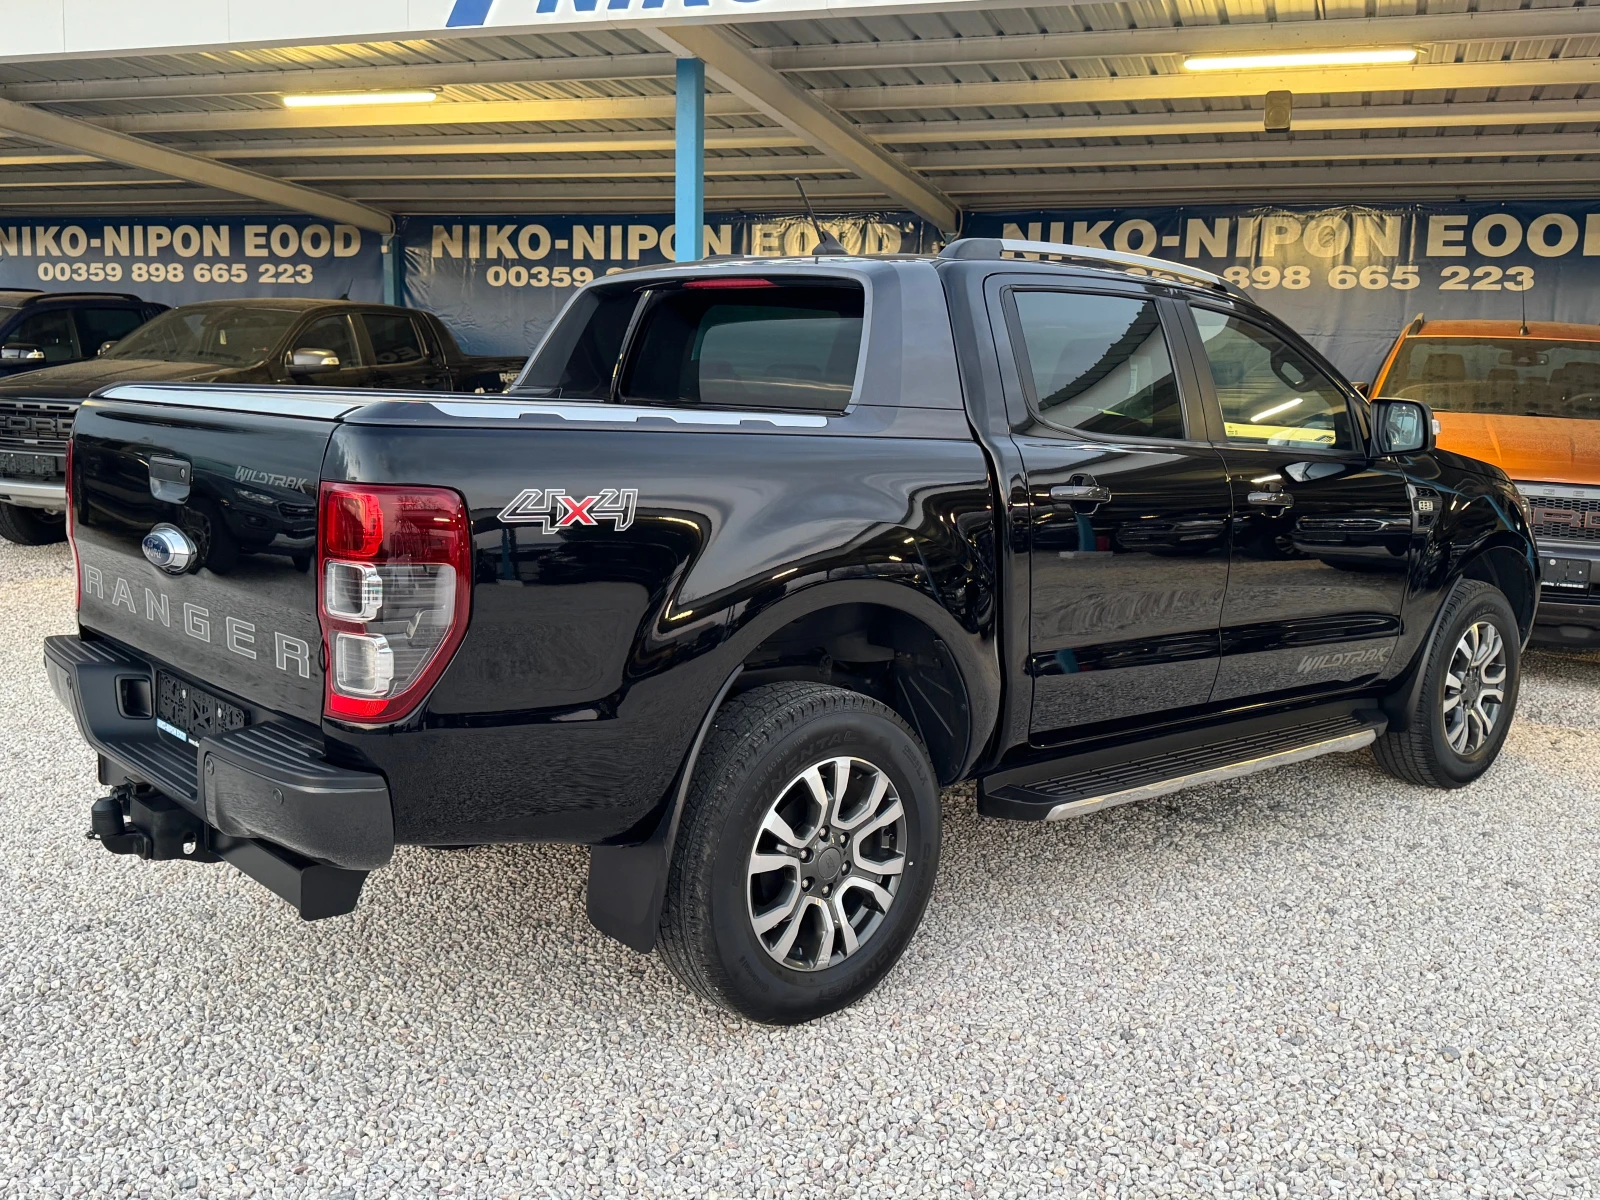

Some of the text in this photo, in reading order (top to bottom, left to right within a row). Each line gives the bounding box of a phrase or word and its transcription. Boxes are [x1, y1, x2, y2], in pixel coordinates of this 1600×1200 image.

[244, 224, 362, 258] EOOD
[37, 262, 314, 284] 00359 898 665 223
[486, 266, 594, 288] 00359
[1223, 264, 1311, 290] 898
[1327, 265, 1421, 290] 665
[1438, 265, 1535, 291] 223
[235, 465, 308, 494] WILDTRAK
[84, 563, 310, 679] RANGER
[1297, 646, 1390, 674] WILDTRAK
